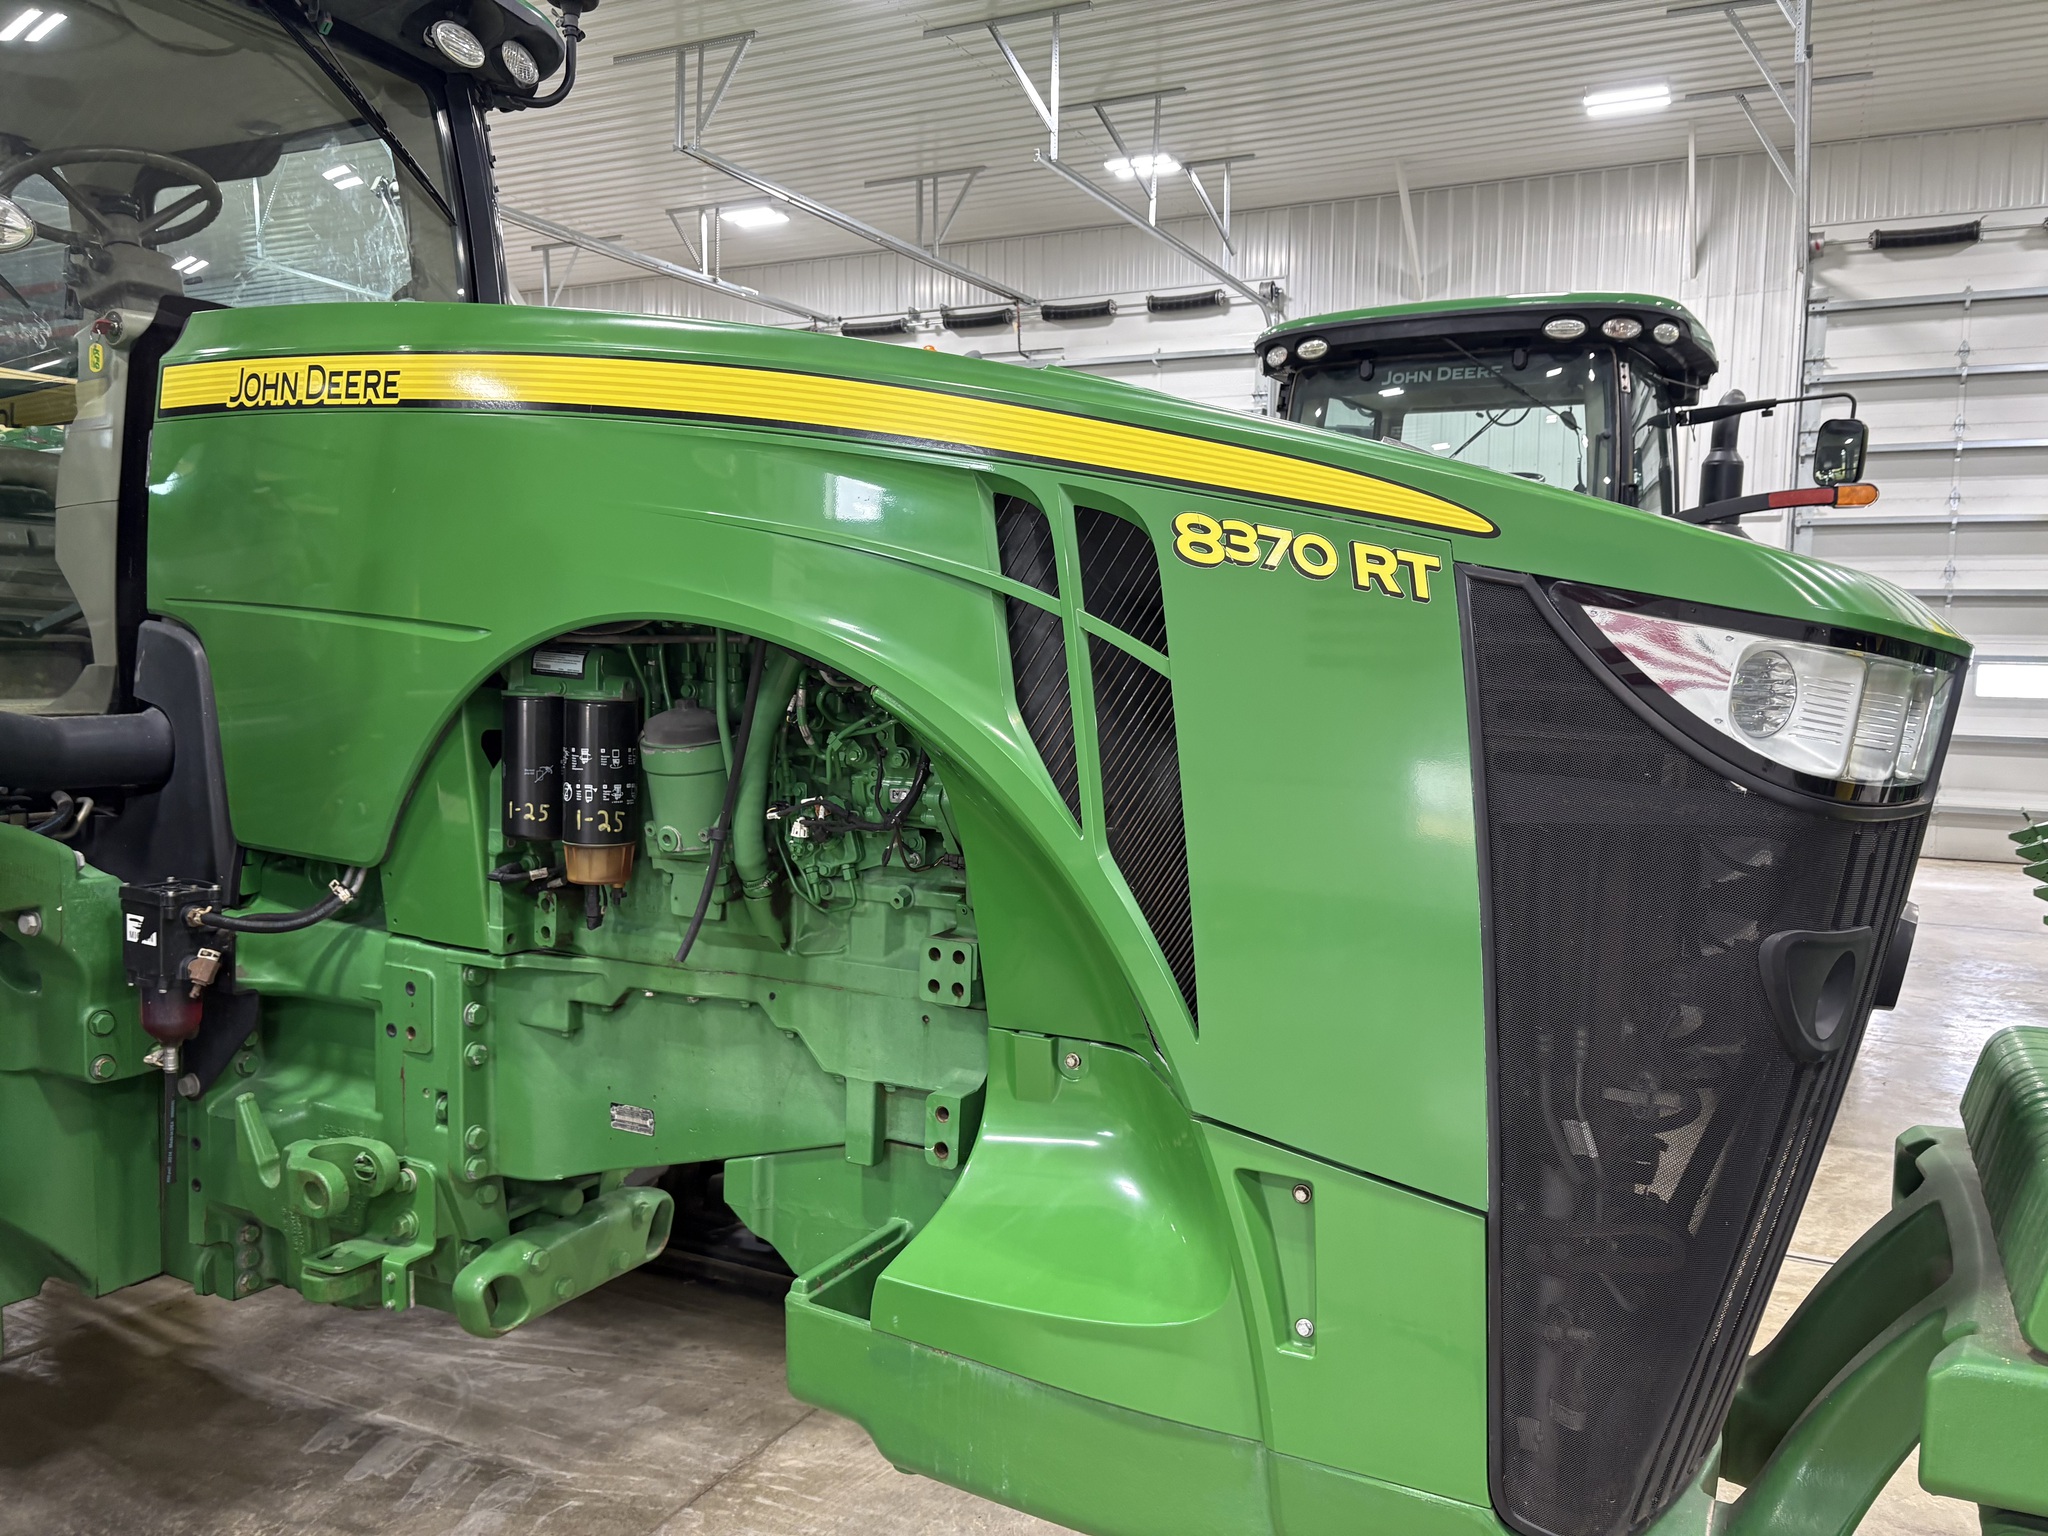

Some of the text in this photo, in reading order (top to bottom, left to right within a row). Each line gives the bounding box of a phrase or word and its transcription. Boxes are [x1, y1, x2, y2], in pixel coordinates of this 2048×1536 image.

[228, 364, 401, 404] JOHN DEERE
[1381, 365, 1503, 386] JOHN DEERE
[1171, 511, 1441, 603] 8370 RT
[508, 801, 550, 822] 1-25
[576, 809, 626, 833] 1-25
